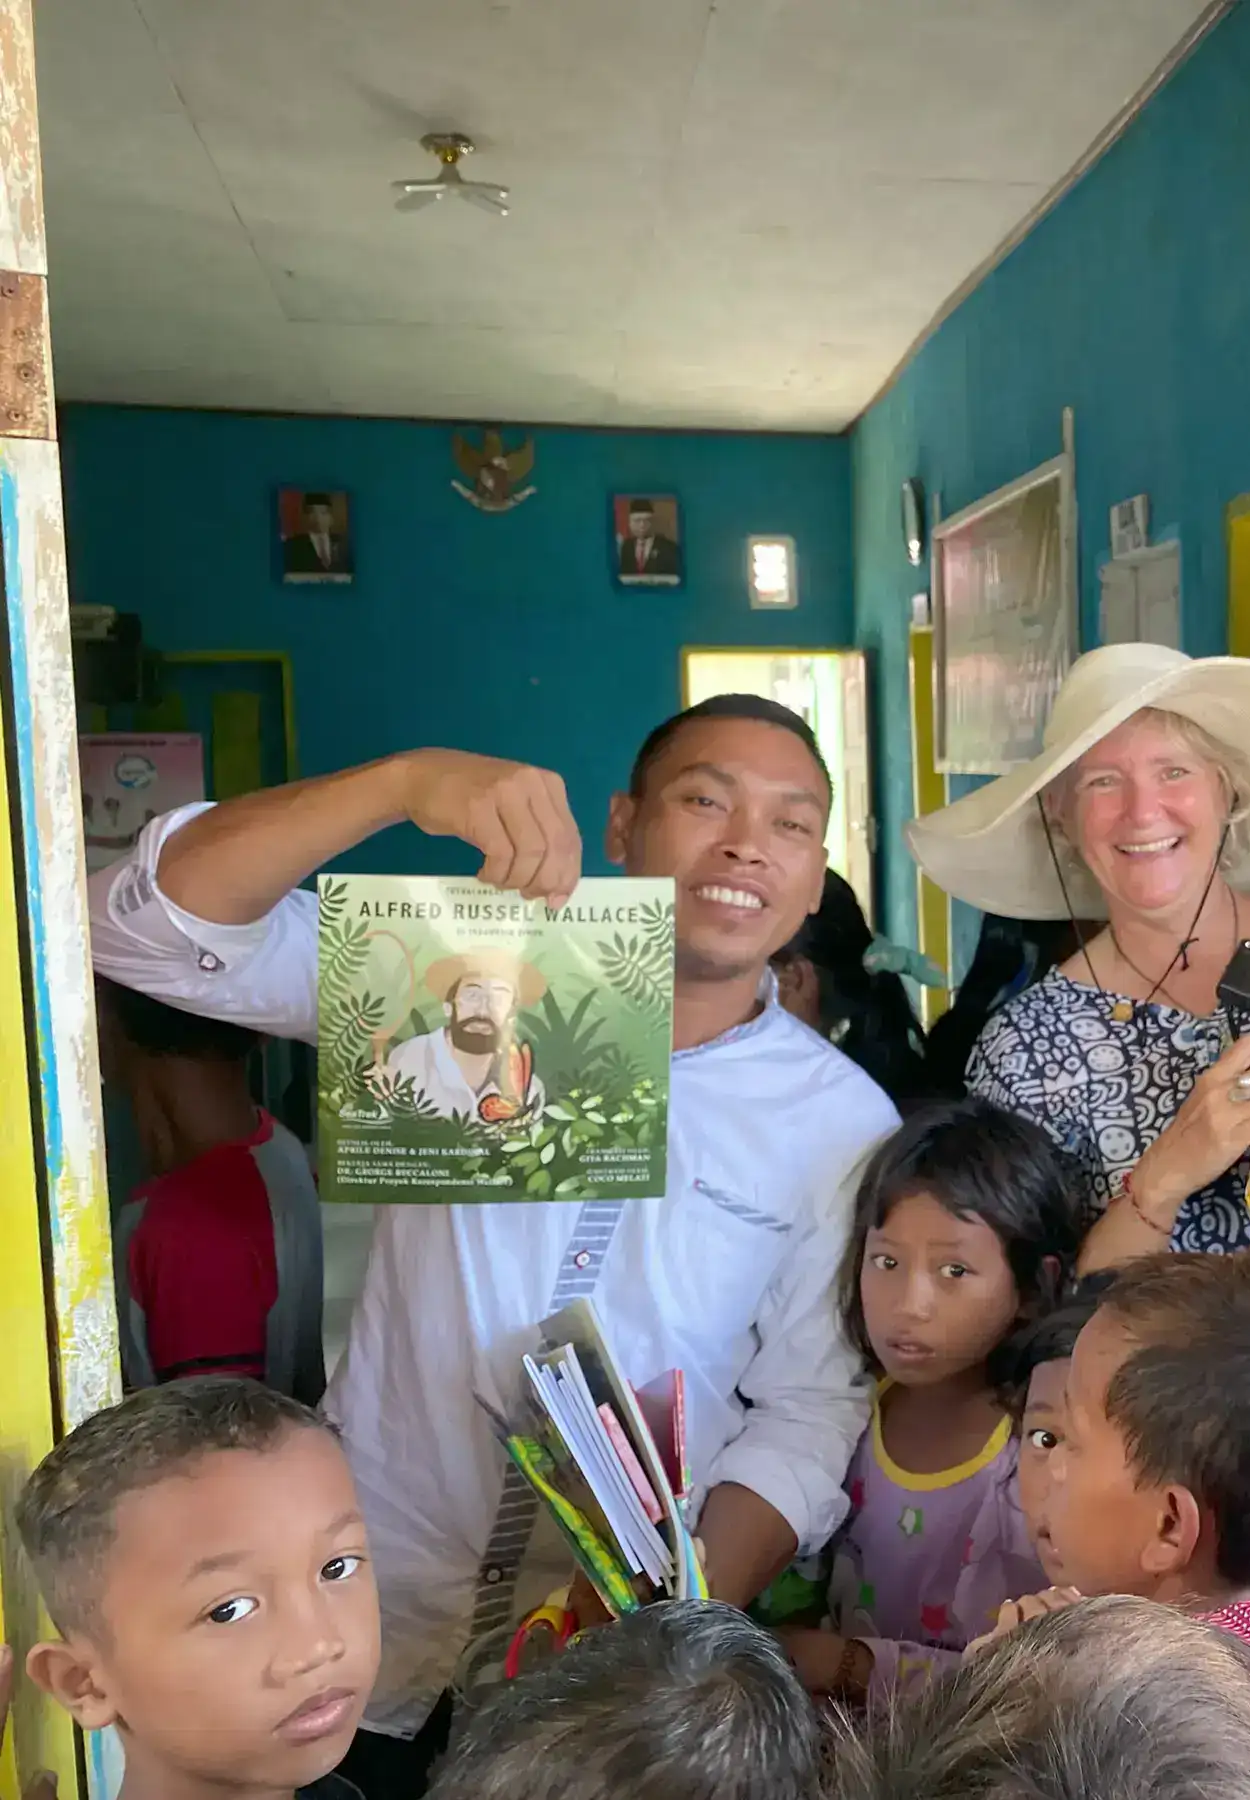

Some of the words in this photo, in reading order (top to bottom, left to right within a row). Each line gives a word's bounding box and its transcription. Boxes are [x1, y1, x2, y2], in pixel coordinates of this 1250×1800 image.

[359, 901, 442, 920] ALFRED
[452, 903, 534, 922] RUSSEL
[544, 905, 639, 923] WALLACE
